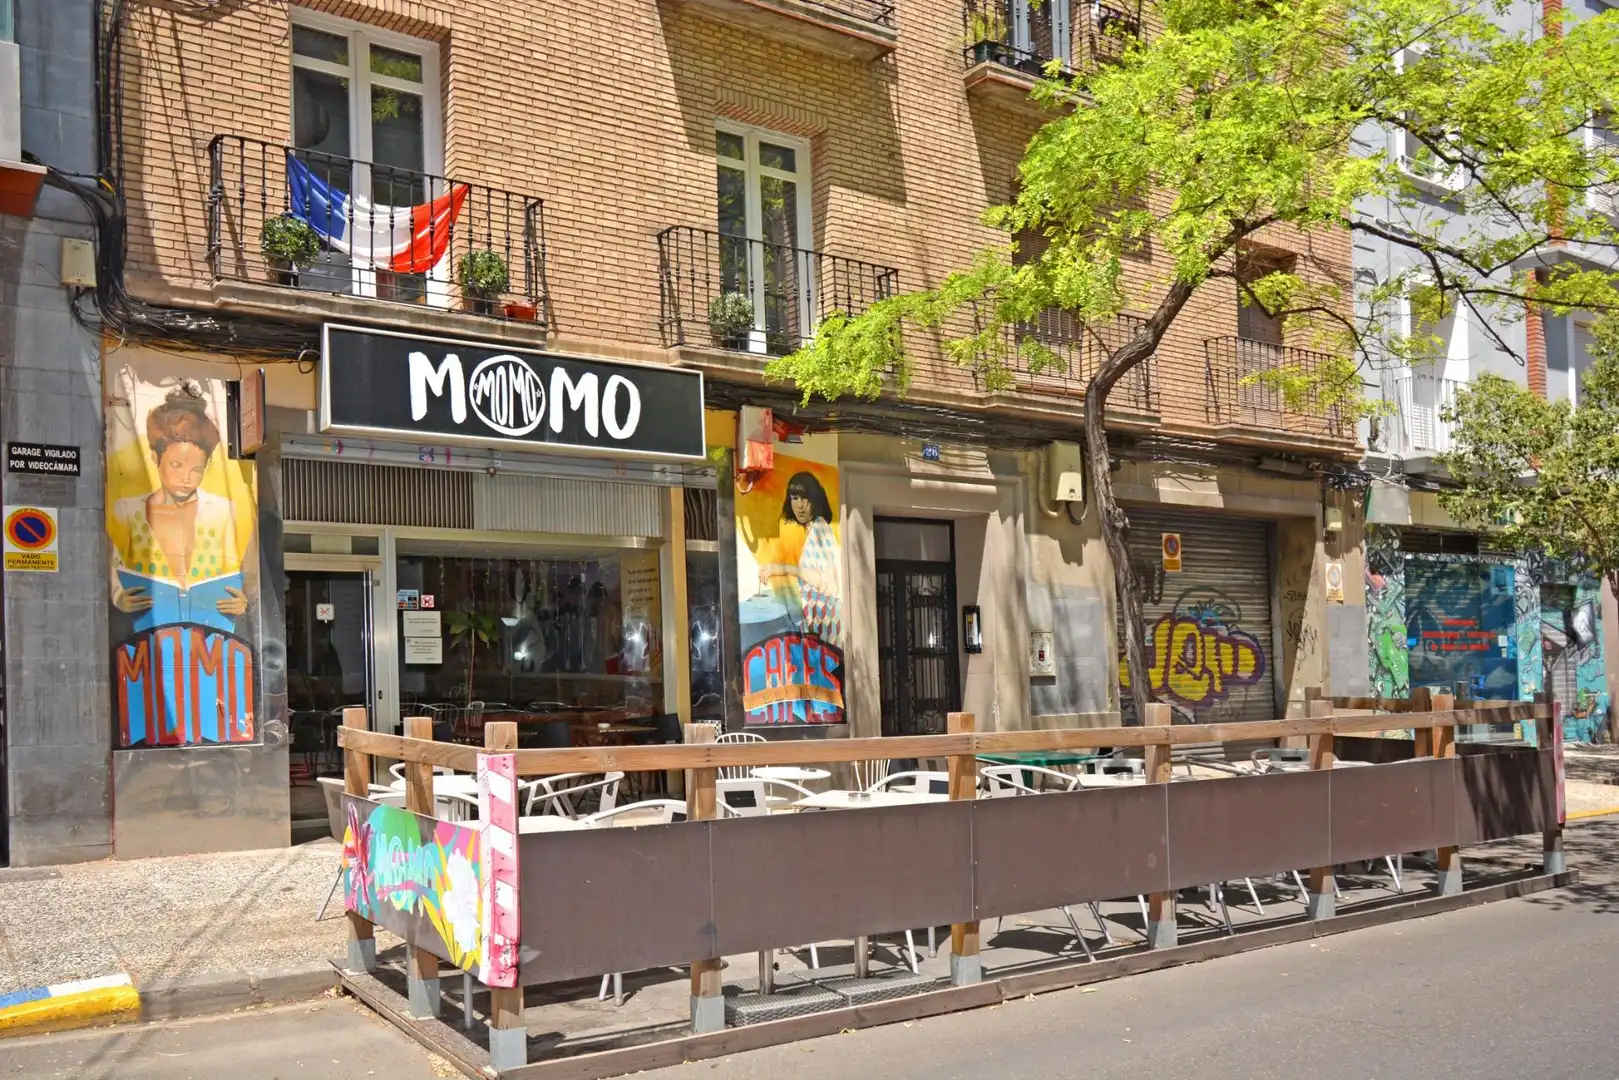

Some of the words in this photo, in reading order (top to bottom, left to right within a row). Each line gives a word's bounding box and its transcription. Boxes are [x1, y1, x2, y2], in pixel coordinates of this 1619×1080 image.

[408, 351, 642, 440] MOMO
[476, 362, 537, 428] MOMO
[9, 460, 25, 469] POR
[28, 460, 78, 472] VIDEOCÁMARA
[11, 447, 41, 457] GARAGE
[45, 449, 77, 459] VIGILADO
[116, 626, 254, 746] MOMO
